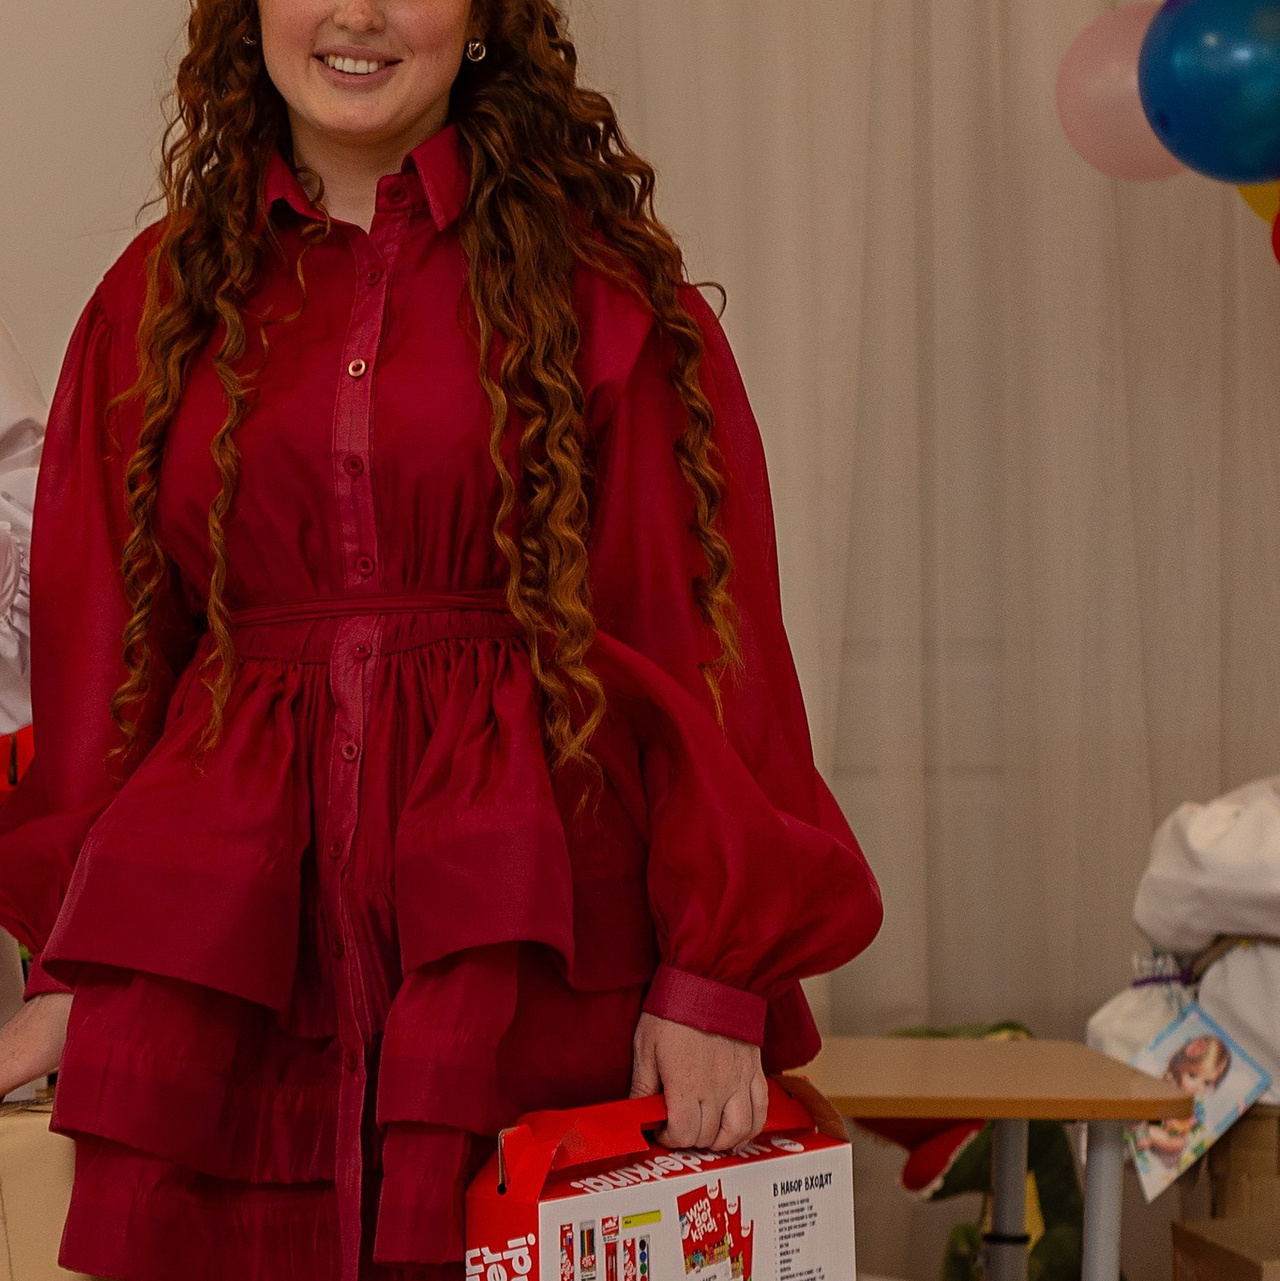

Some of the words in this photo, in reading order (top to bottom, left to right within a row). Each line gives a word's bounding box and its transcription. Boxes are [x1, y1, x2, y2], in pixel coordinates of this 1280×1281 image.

[773, 1182, 779, 1197] В
[780, 1179, 803, 1196] НАБОР
[804, 1172, 832, 1191] ВХОДЯТ
